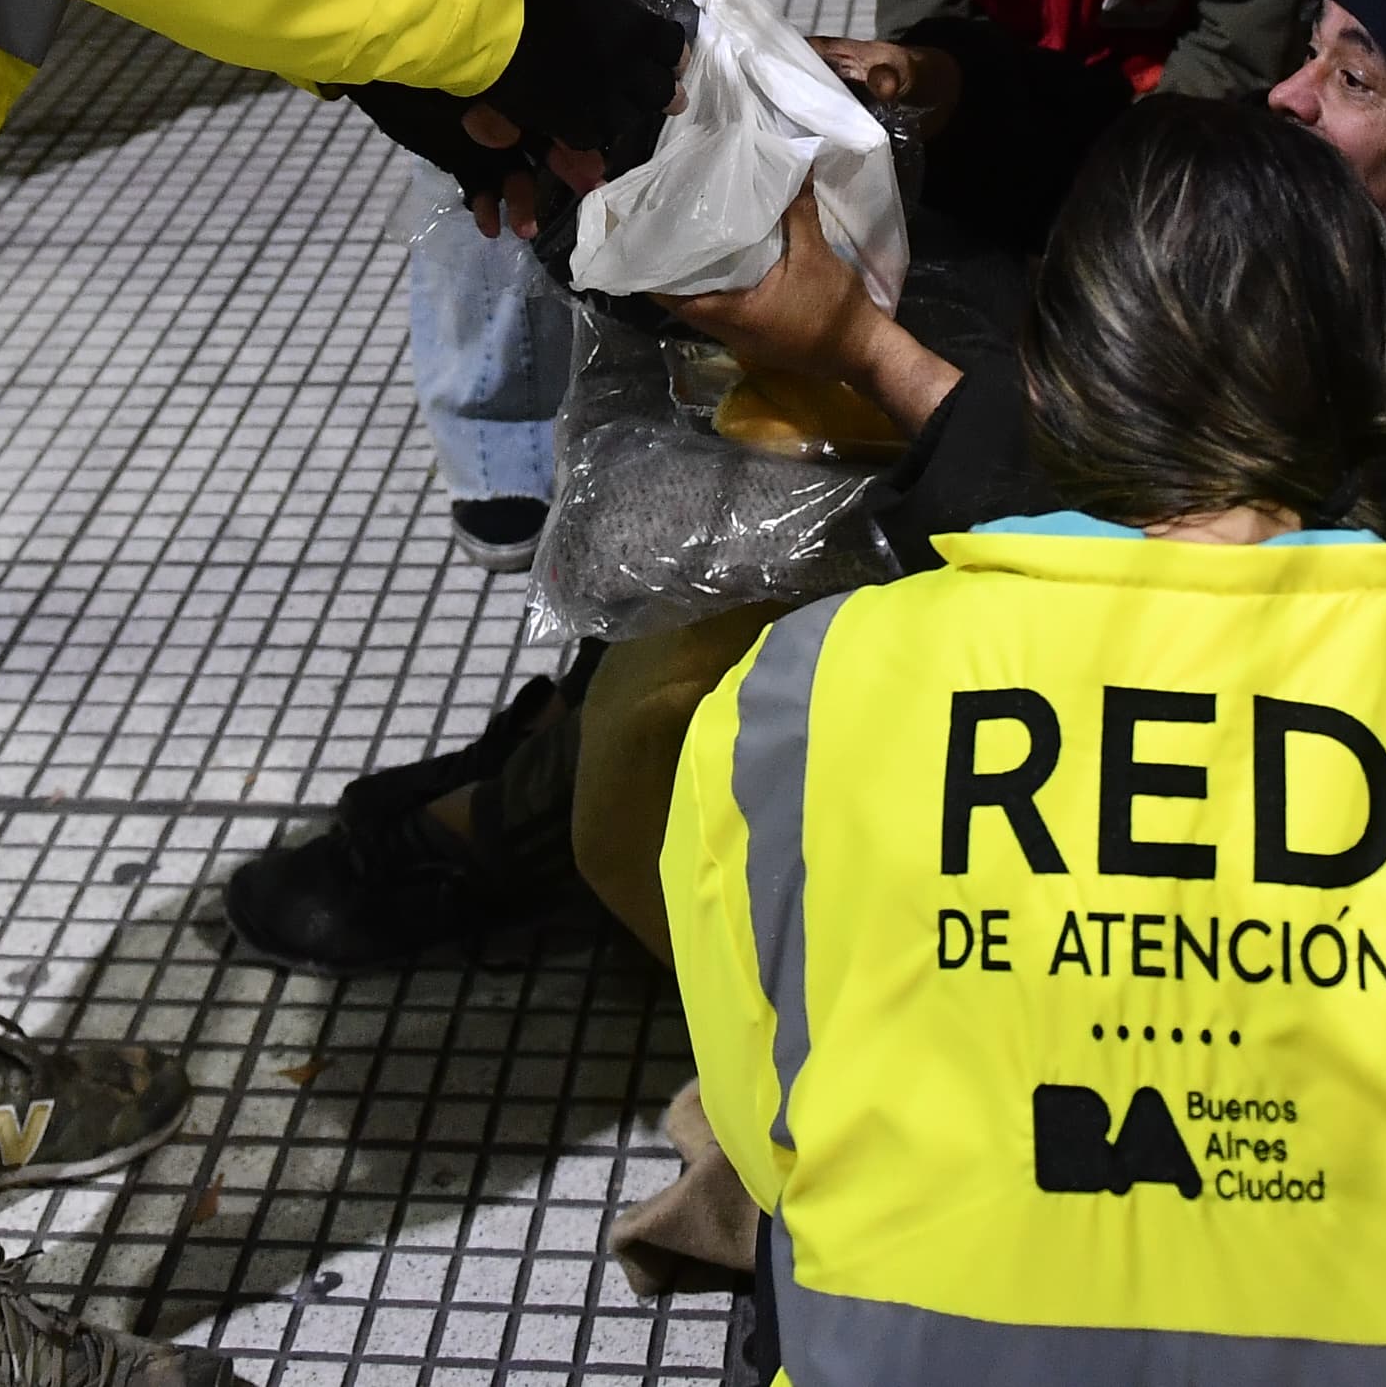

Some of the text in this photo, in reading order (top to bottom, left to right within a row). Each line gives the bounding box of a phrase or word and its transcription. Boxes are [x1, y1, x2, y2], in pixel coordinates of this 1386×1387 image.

[937, 908, 1013, 972] DE
[1186, 1090, 1299, 1124] Buenos
[1032, 1082, 1204, 1201] BA
[1205, 1130, 1288, 1163] Aires
[1214, 1167, 1327, 1202] Ciudad
